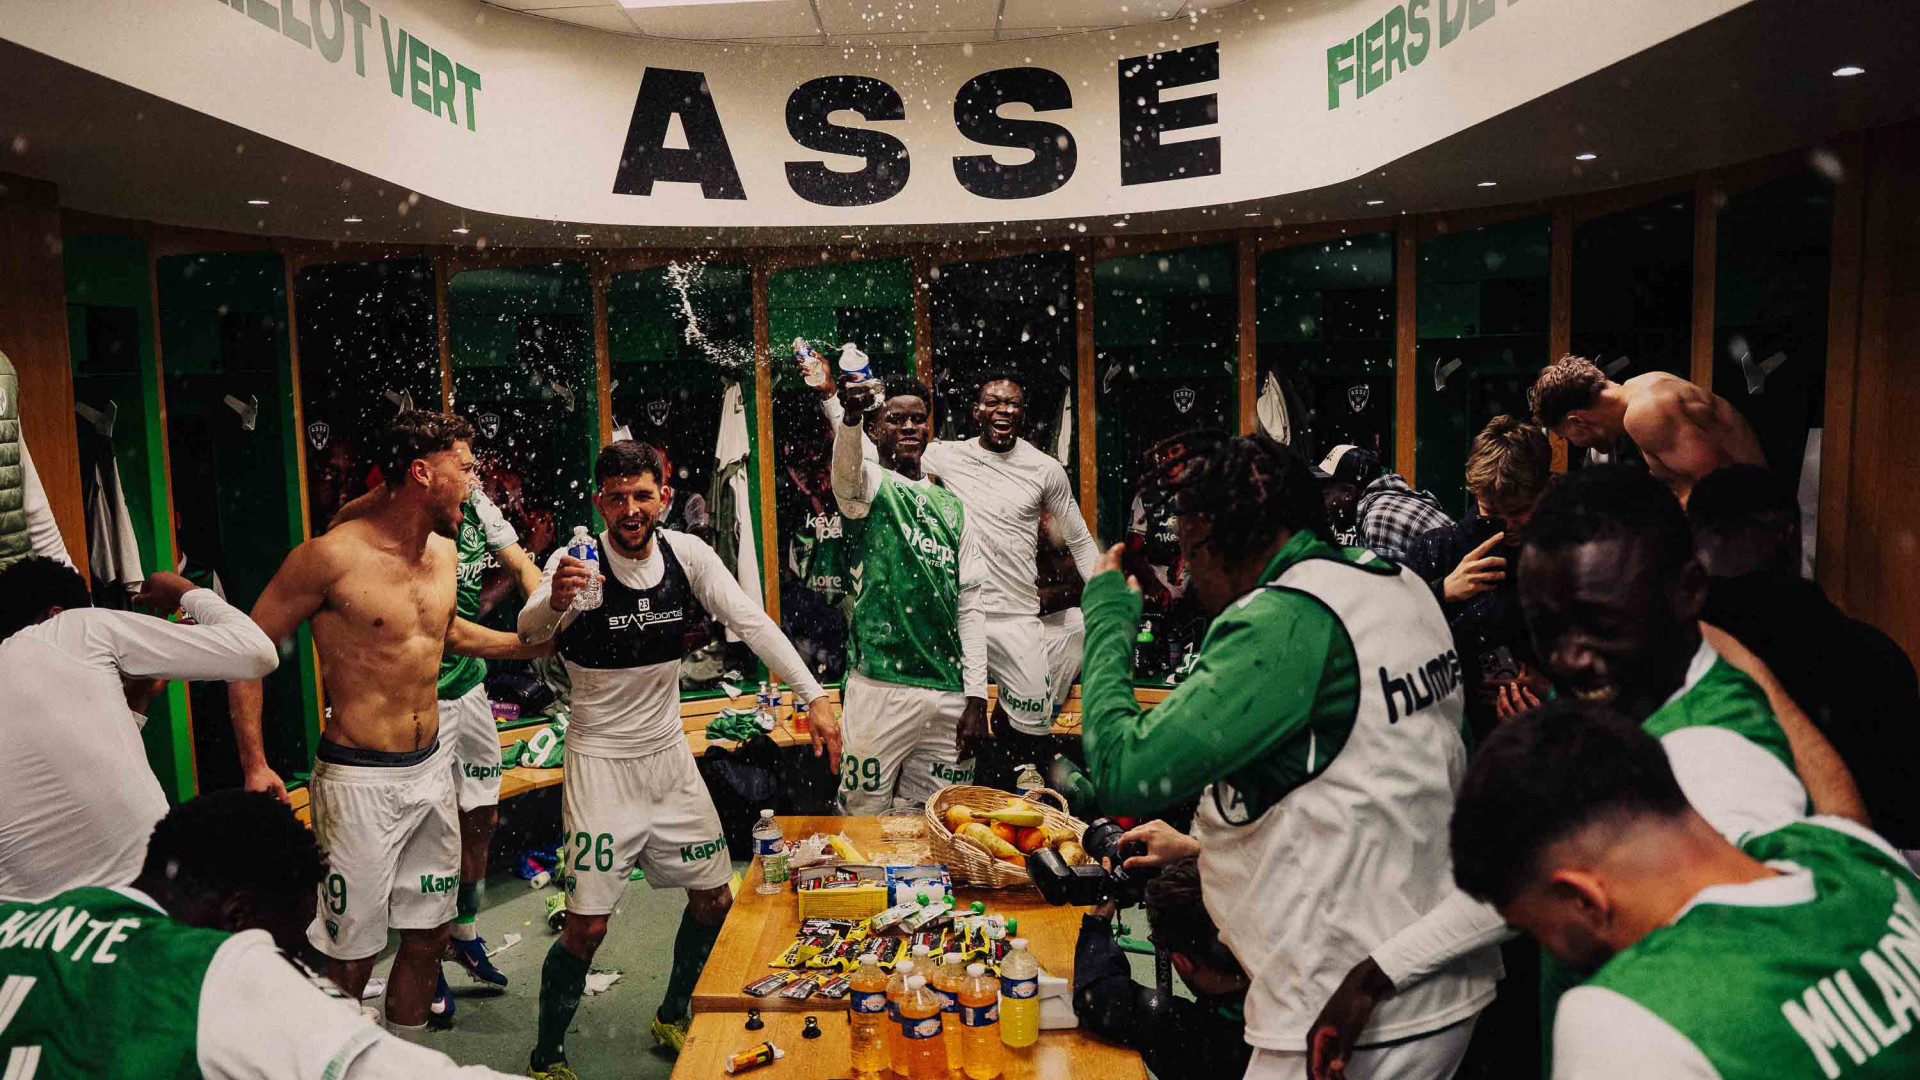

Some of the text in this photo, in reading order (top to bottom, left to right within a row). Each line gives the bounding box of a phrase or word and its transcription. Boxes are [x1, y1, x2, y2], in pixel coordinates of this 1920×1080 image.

[379, 14, 482, 132] VERT
[1327, 0, 1430, 110] FIERS
[612, 41, 1221, 207] ASSE
[609, 608, 683, 629] STATSports
[639, 600, 649, 609] 23
[521, 727, 557, 768] 9
[844, 755, 880, 792] 39
[931, 763, 975, 785] Kapri
[574, 831, 614, 872] 26
[680, 833, 727, 863] Kapri
[328, 873, 347, 915] 9
[420, 869, 460, 897] Kapri
[0, 906, 141, 963] KANTE
